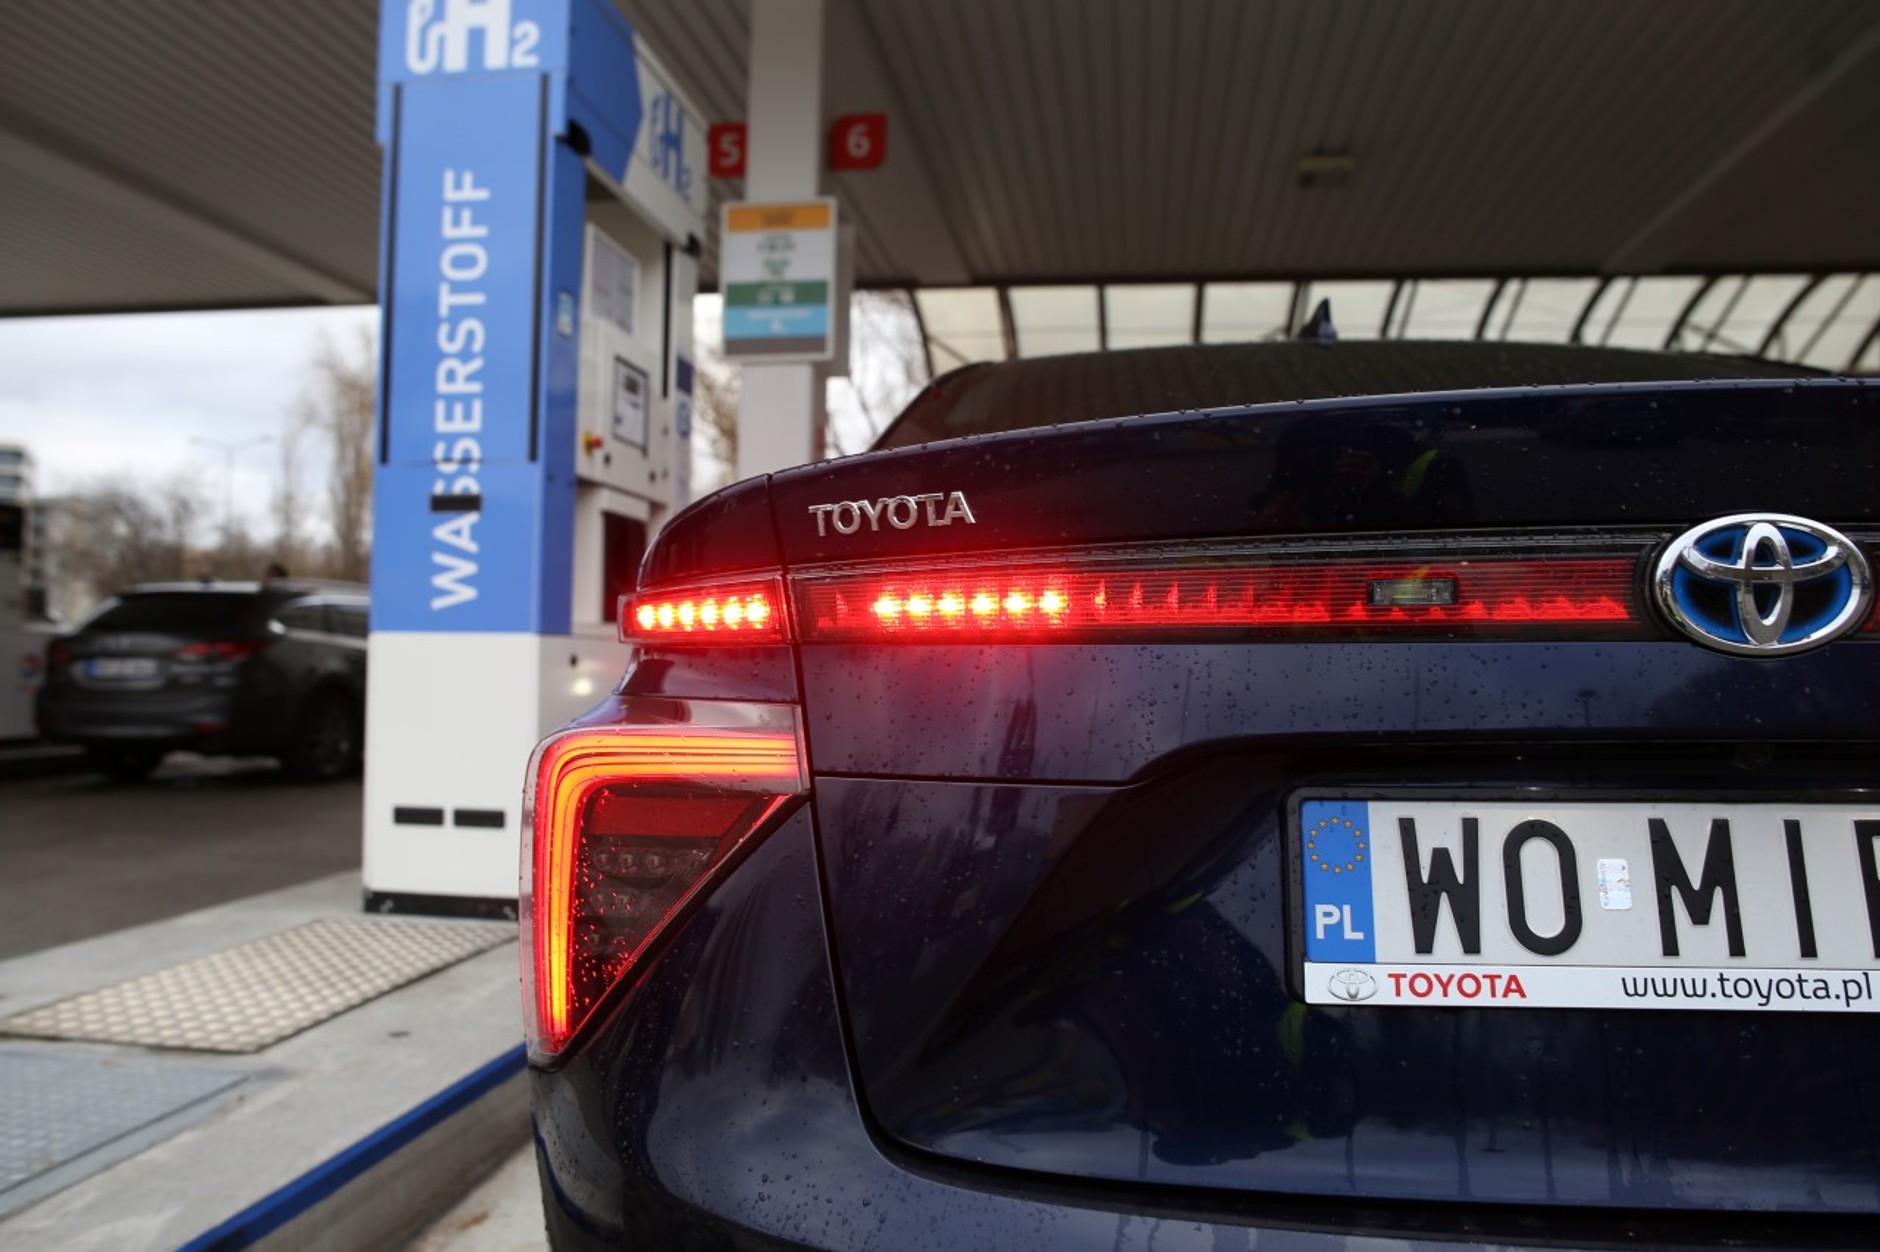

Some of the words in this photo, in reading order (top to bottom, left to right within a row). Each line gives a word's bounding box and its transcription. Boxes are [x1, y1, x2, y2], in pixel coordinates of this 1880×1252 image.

[718, 133, 742, 168] 5
[846, 124, 871, 158] 6
[431, 168, 491, 611] WASSERSTOFF
[808, 491, 976, 537] TOYOTA
[1398, 816, 1583, 957] WO
[1315, 904, 1364, 940] PL
[1387, 972, 1527, 999] TOYOTA
[1621, 972, 1873, 1008] www.toyota.pl
